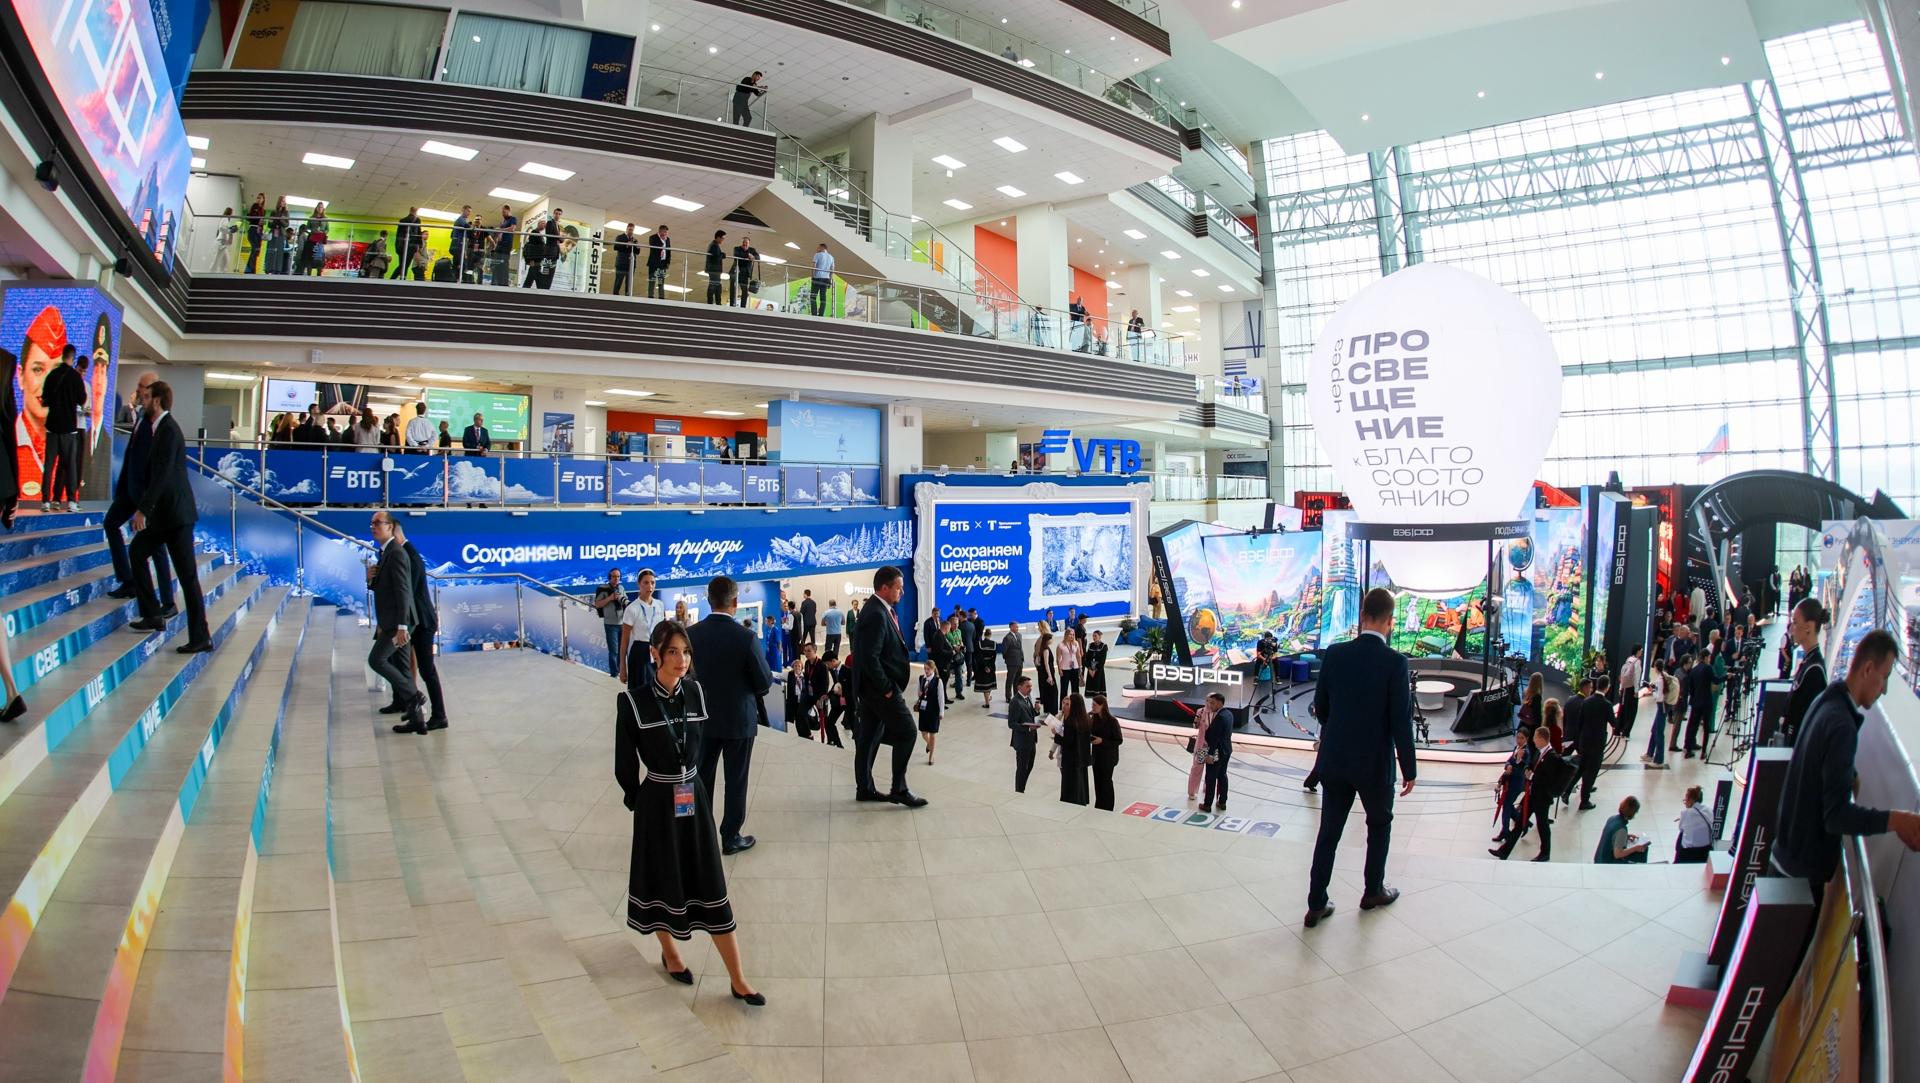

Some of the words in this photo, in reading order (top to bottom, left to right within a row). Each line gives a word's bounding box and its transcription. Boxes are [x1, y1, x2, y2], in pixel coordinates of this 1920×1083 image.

[1348, 329, 1430, 358] ПРО
[1347, 356, 1429, 385] СВЕ
[1349, 387, 1417, 413] ЩЕ
[1354, 416, 1444, 441] НИЕ
[1072, 438, 1142, 473] VTB
[1363, 446, 1473, 466] БЛАГО
[347, 470, 382, 489] ВТБ
[575, 475, 605, 492] ВТБ
[757, 478, 780, 493] ВТБ
[1372, 467, 1484, 486] СОСТО
[1378, 489, 1470, 507] ЯНИЮ
[949, 521, 970, 532] ВТБ
[462, 543, 572, 566] Сохраняем
[580, 543, 661, 561] шедевры
[667, 538, 744, 565] природы
[940, 544, 1023, 561] Сохраняем
[940, 560, 1009, 574] шедевры
[940, 574, 1012, 596] природы
[35, 642, 60, 678] СВЕ
